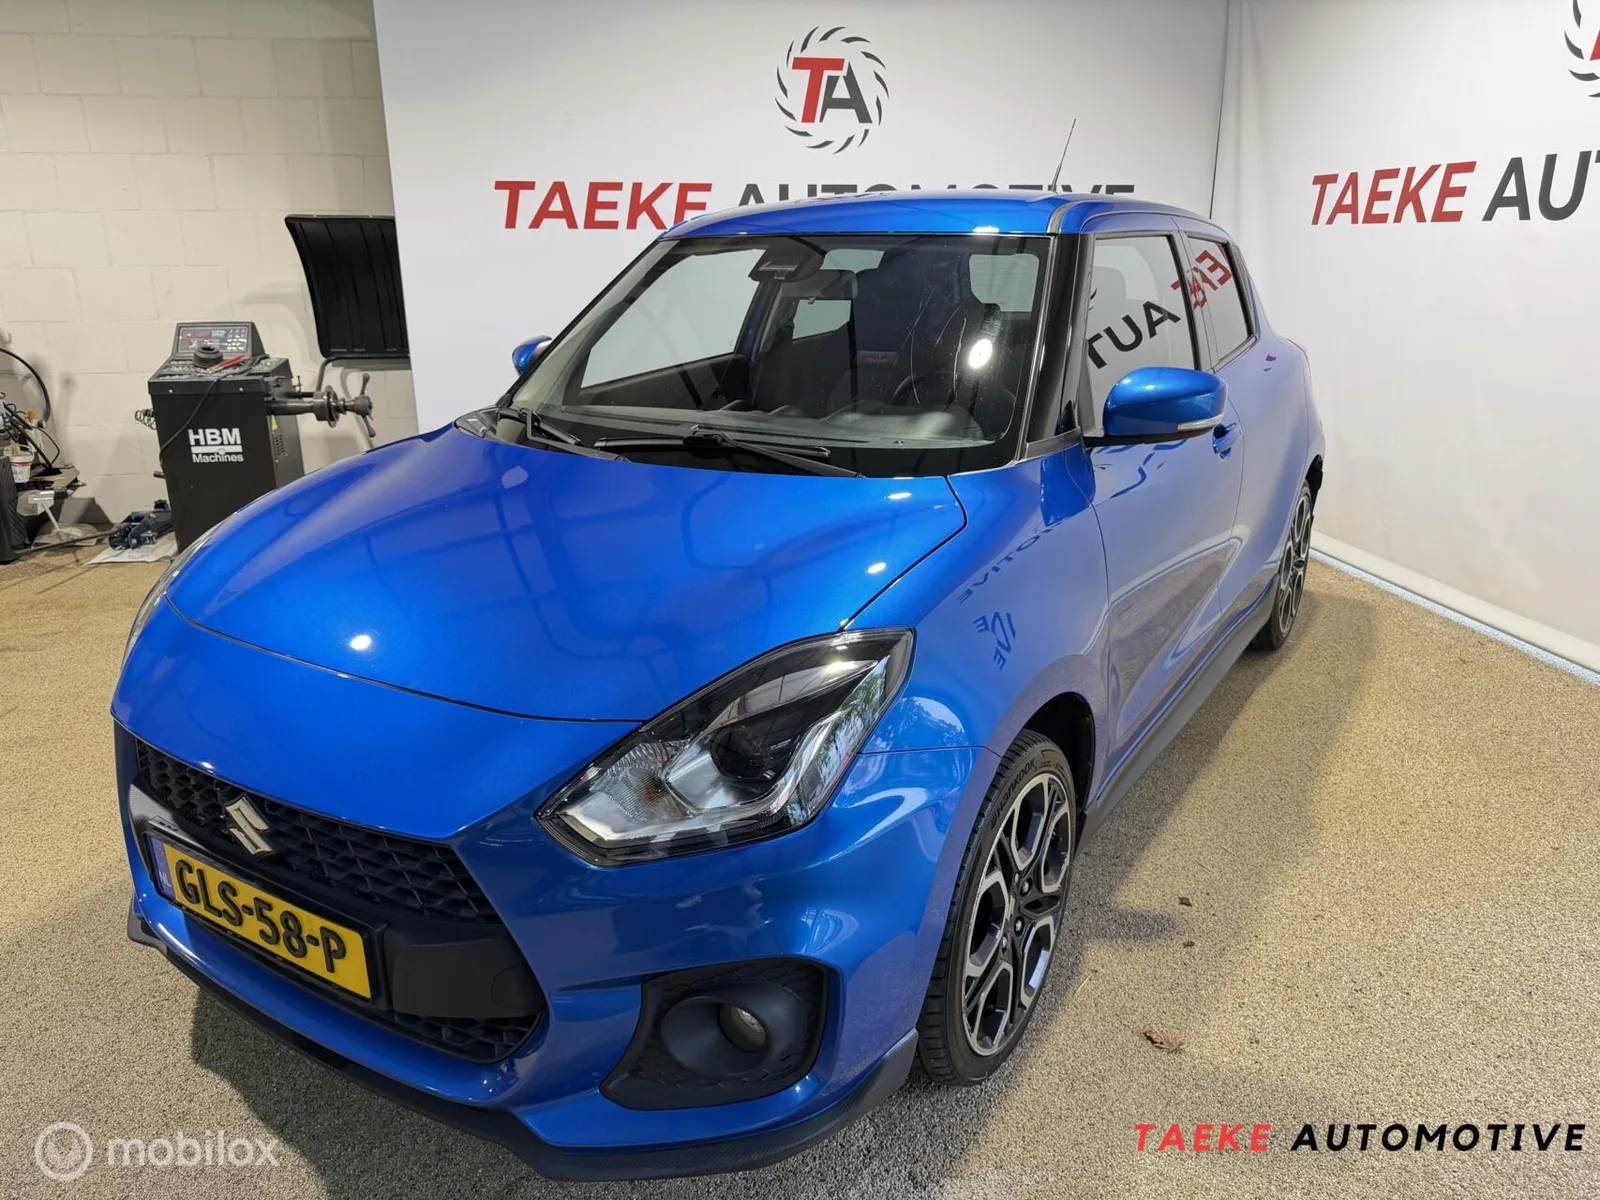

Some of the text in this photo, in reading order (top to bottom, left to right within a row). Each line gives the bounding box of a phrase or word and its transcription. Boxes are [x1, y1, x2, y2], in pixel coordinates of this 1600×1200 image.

[792, 57, 872, 123] TA
[1312, 150, 1600, 226] TAEKE AU
[188, 427, 242, 446] HBM
[192, 452, 244, 463] Machines
[159, 859, 347, 974] NL GLS-58-P
